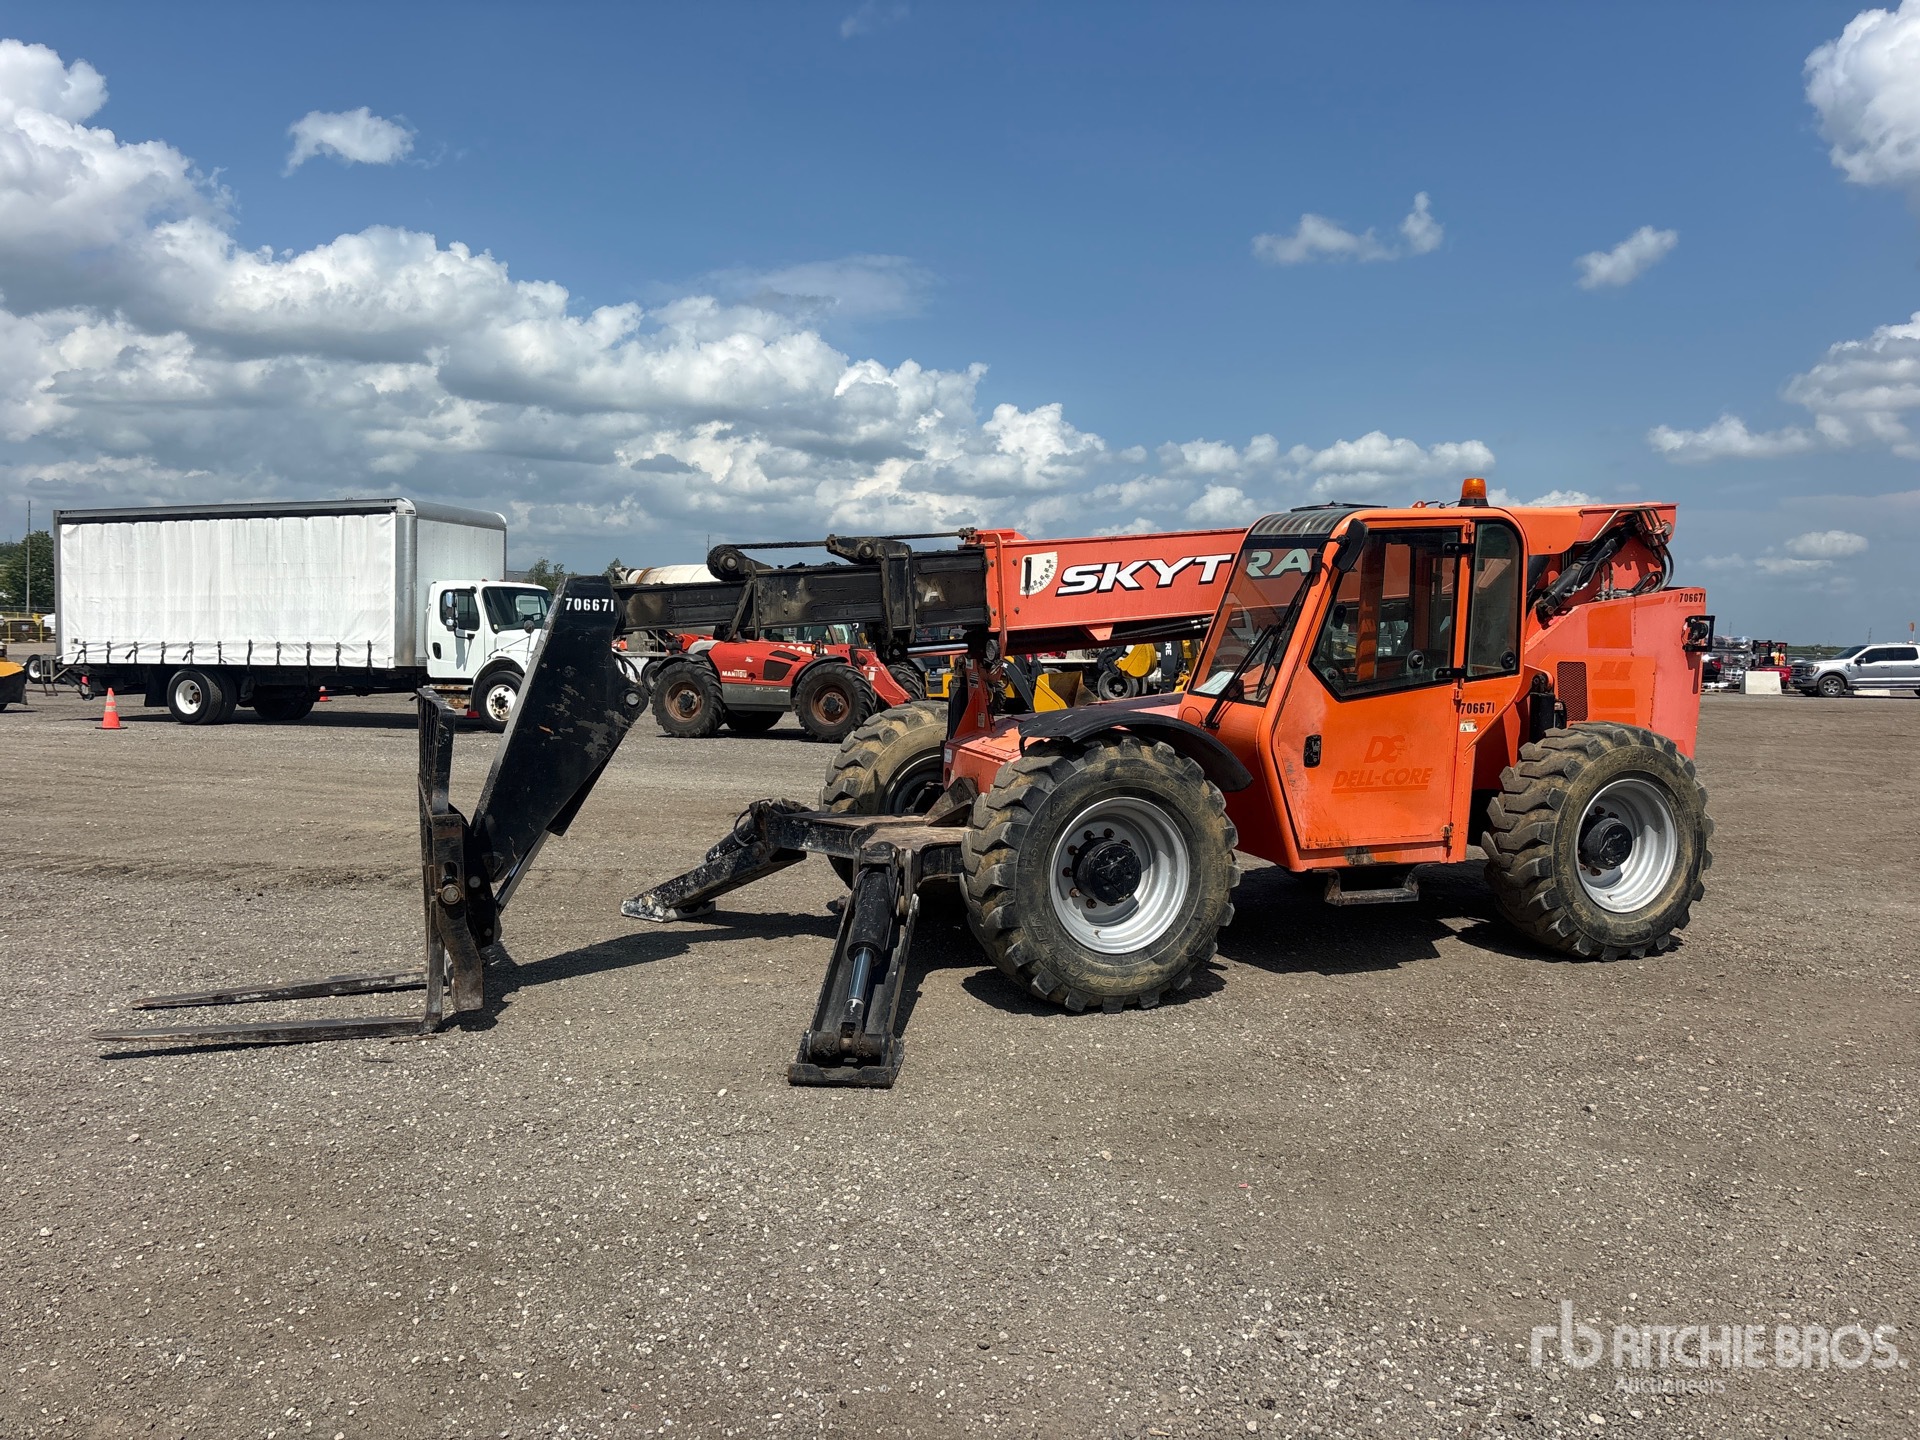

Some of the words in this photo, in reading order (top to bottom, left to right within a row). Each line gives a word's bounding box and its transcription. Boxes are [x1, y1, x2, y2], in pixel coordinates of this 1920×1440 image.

[1055, 548, 1314, 597] SKYTRA
[565, 597, 614, 612] 706671
[1680, 592, 1706, 603] 706671
[1164, 640, 1173, 656] RE
[1460, 702, 1495, 714] 706671
[1332, 767, 1434, 788] DELL-CORE
[1028, 911, 1163, 989] LOADMASTER
